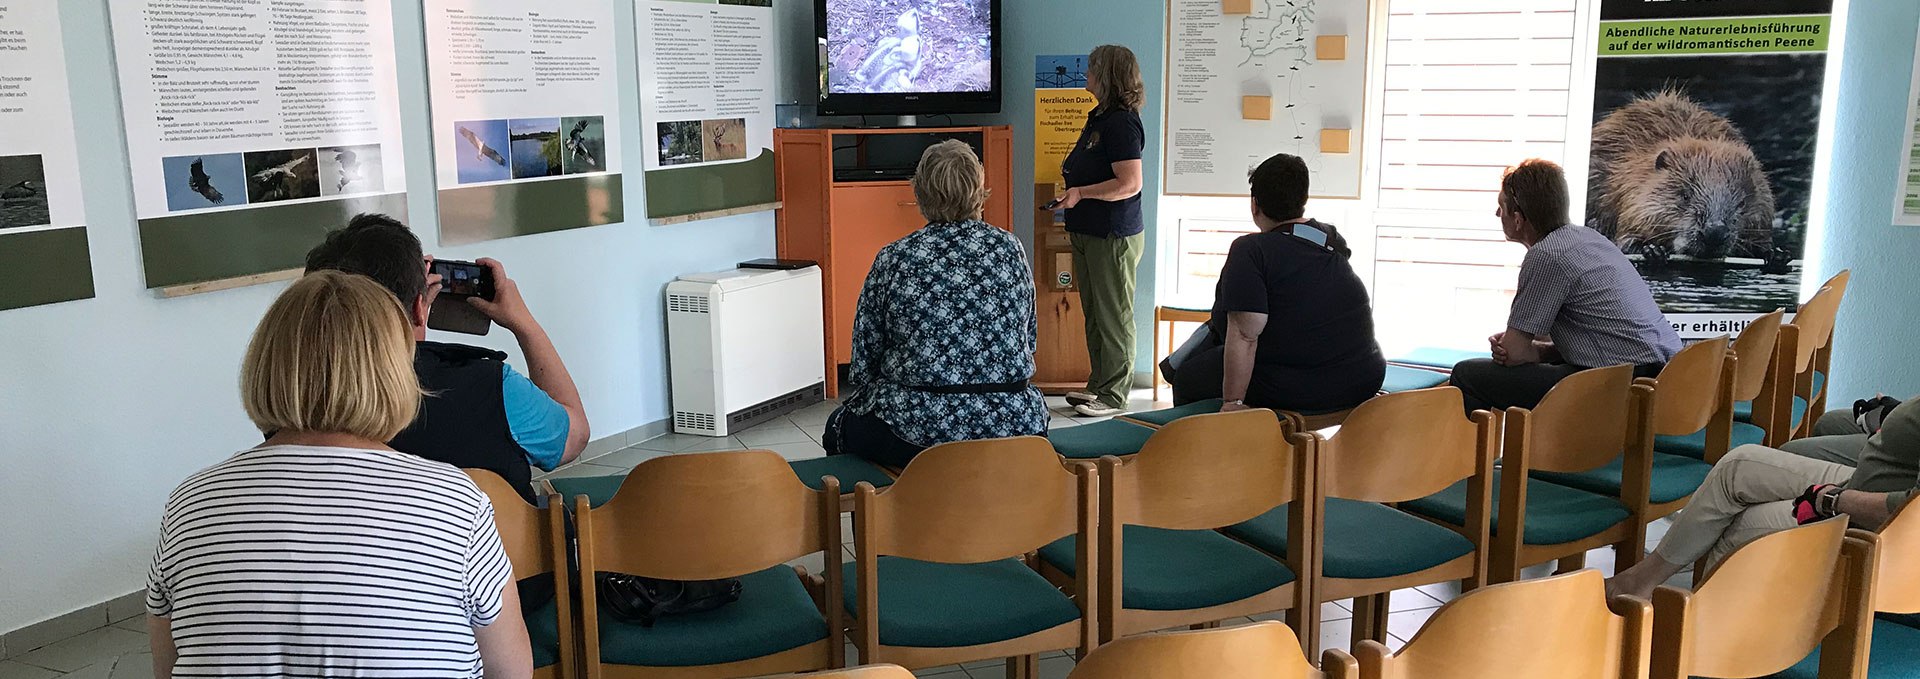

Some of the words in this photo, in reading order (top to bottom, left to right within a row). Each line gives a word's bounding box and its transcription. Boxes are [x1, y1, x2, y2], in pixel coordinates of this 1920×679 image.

[1606, 26, 1674, 37] Abendliche
[1680, 23, 1820, 35] Naturerlebnisführung
[1608, 41, 1628, 50] auf
[1632, 40, 1652, 50] der
[1657, 38, 1770, 50] wildromantischen
[1775, 38, 1814, 47] Peene
[1670, 322, 1687, 332] er
[1692, 321, 1750, 332] erhältl
